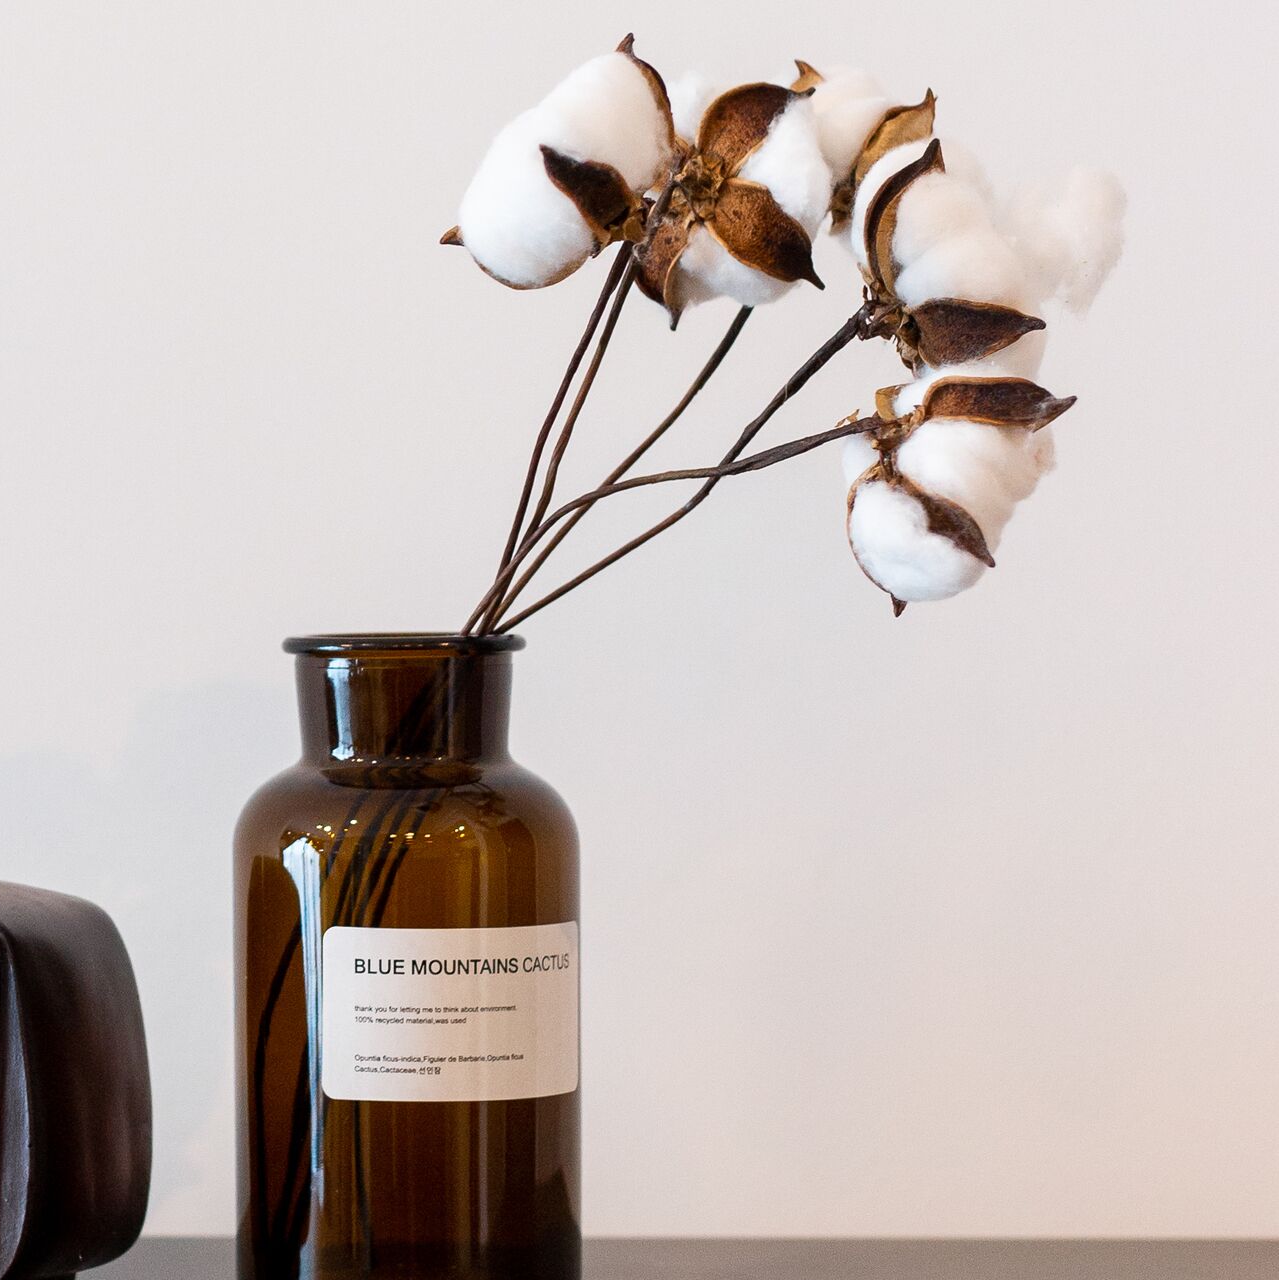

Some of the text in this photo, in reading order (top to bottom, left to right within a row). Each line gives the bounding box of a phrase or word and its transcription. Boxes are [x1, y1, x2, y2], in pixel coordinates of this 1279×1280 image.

[354, 952, 570, 976] BLUE MOUNTAINS CACTUS
[375, 1006, 387, 1014] you
[375, 1017, 404, 1025] recycled
[354, 1054, 381, 1062] Opuntia
[448, 1055, 457, 1063] de
